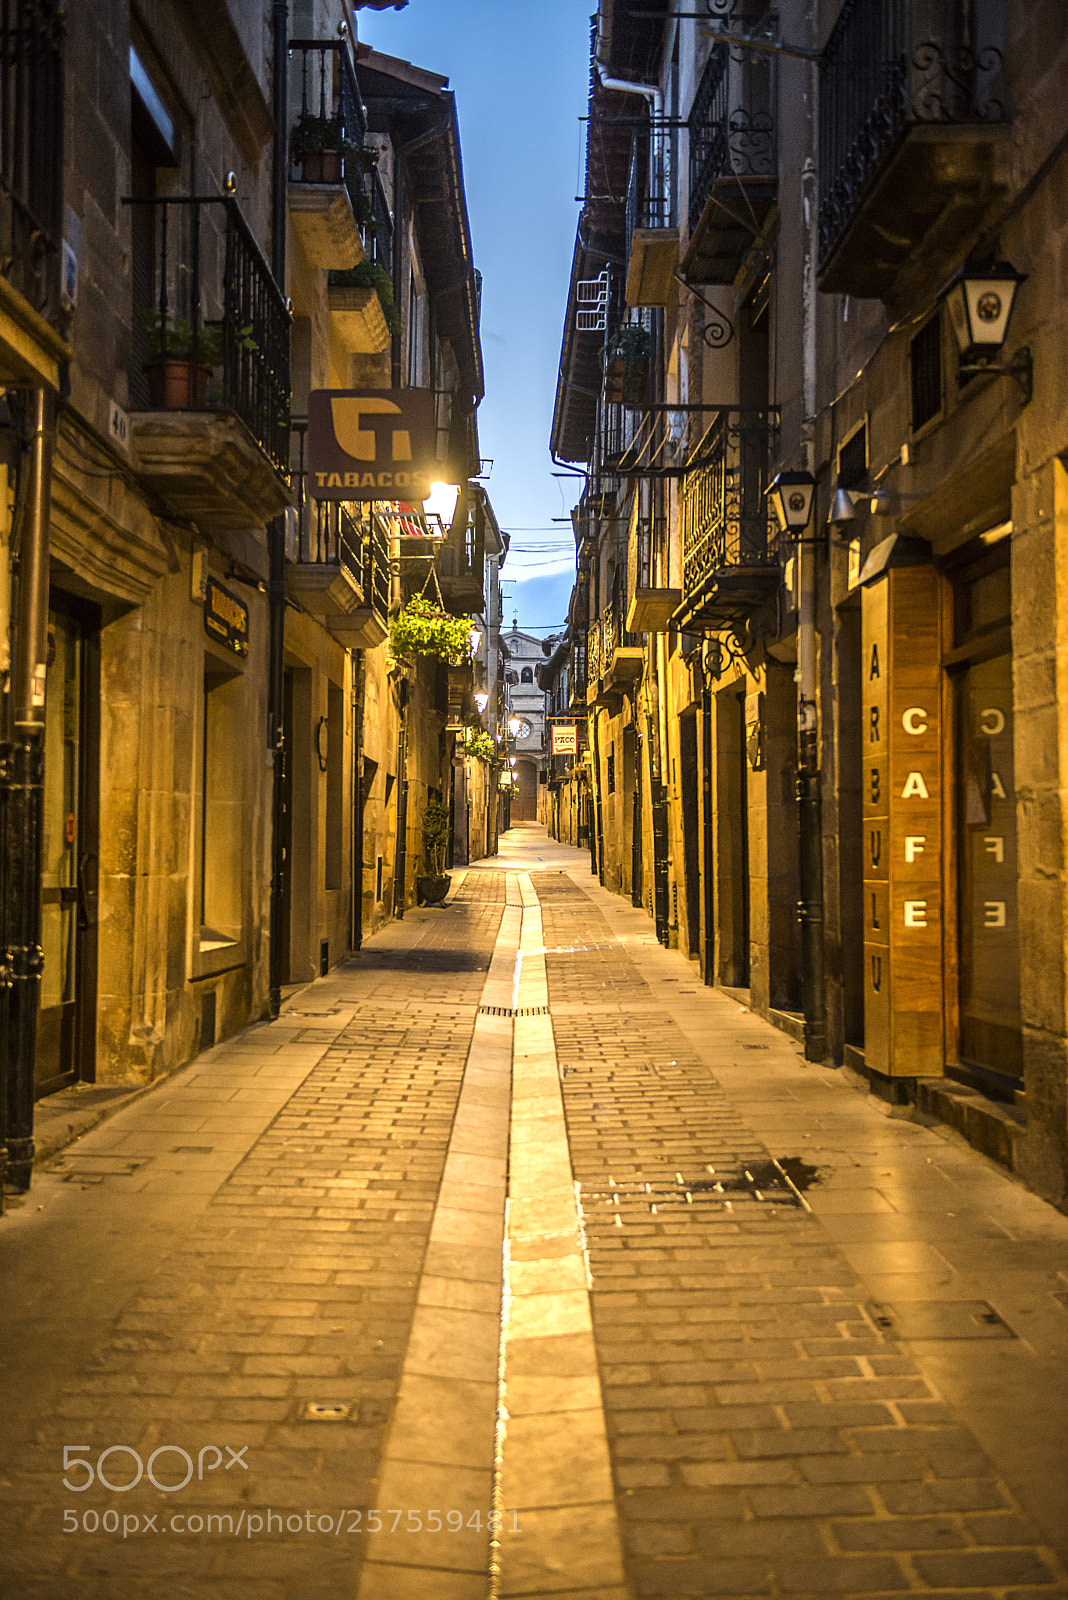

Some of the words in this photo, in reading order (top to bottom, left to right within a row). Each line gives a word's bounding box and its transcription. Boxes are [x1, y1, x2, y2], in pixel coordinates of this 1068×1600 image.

[315, 472, 426, 488] TABACOS
[554, 736, 575, 744] PACO
[869, 643, 882, 993] ARBULU
[901, 707, 930, 927] CAFE
